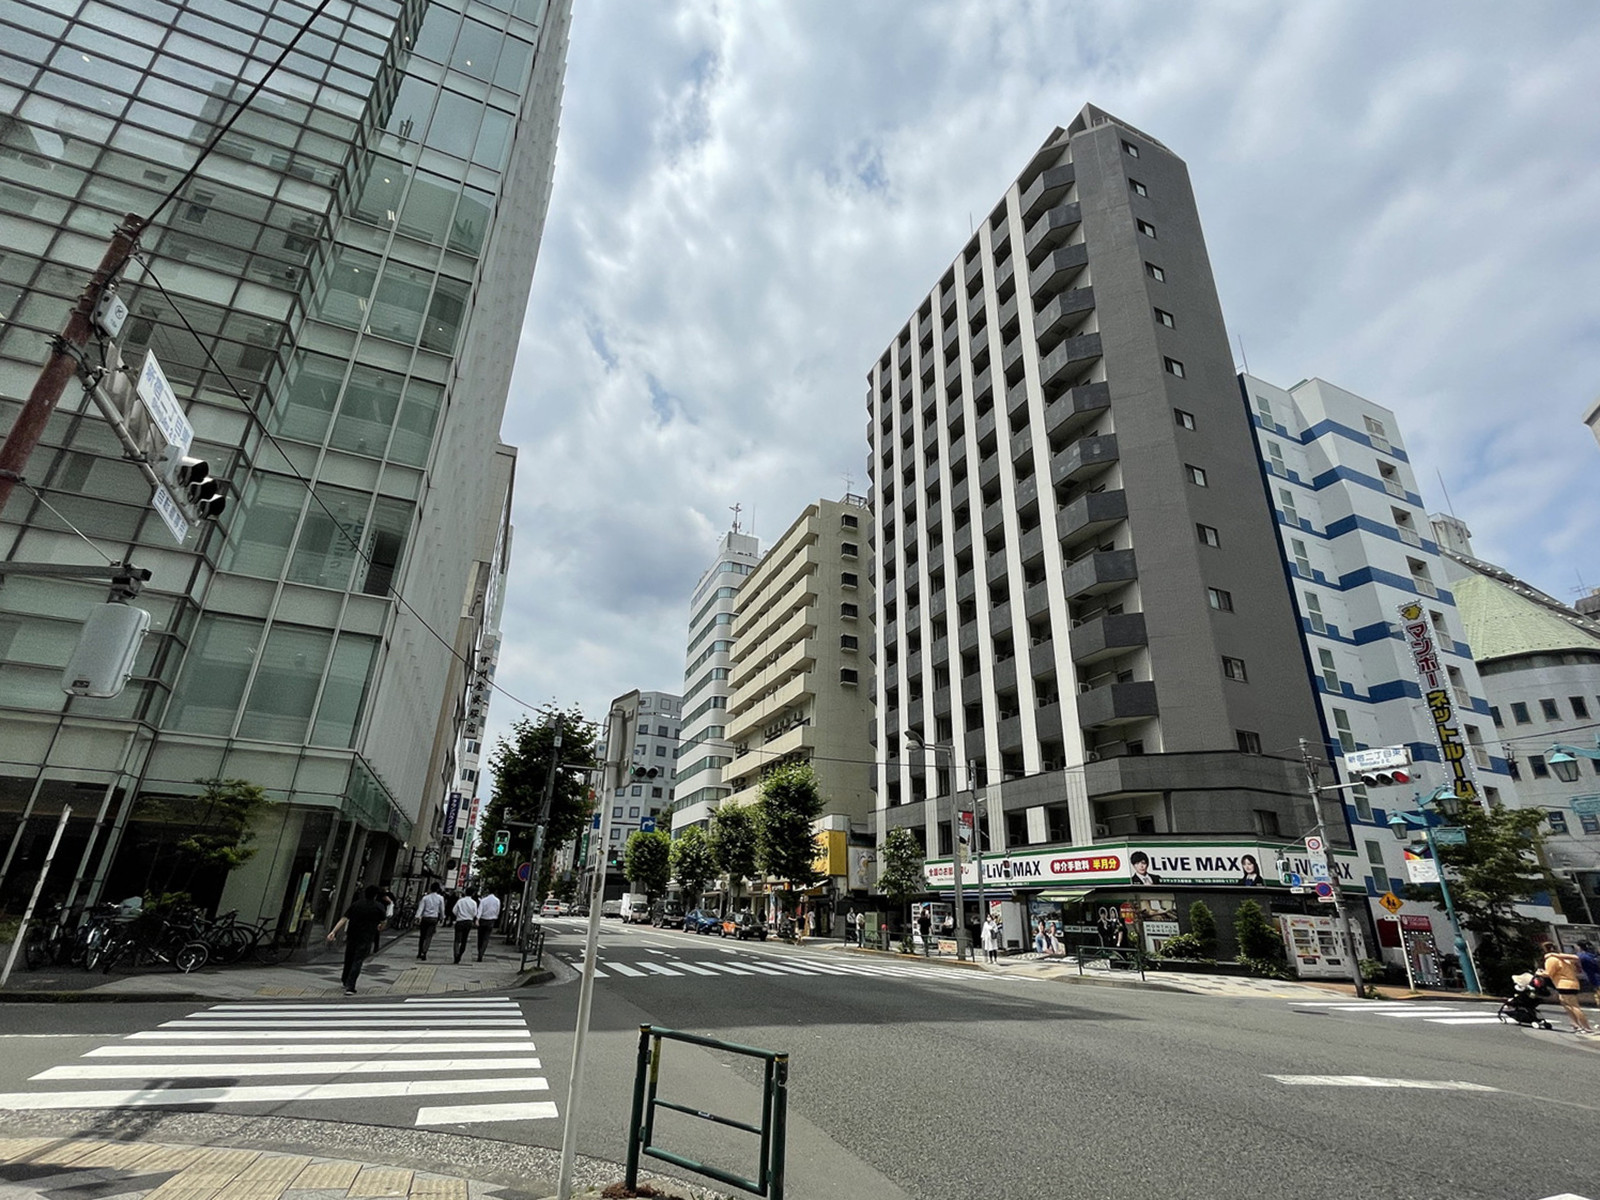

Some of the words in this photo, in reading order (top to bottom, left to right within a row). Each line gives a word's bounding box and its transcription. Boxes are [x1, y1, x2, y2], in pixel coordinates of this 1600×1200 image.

[1407, 621, 1440, 688] マンボー
[1426, 689, 1478, 800] ネットルーム
[986, 862, 1010, 879] LiV
[1013, 860, 1042, 878] MAX
[1092, 858, 1117, 869] 半月分
[1196, 857, 1241, 871] MAX
[928, 866, 970, 877] 全国のお部し
